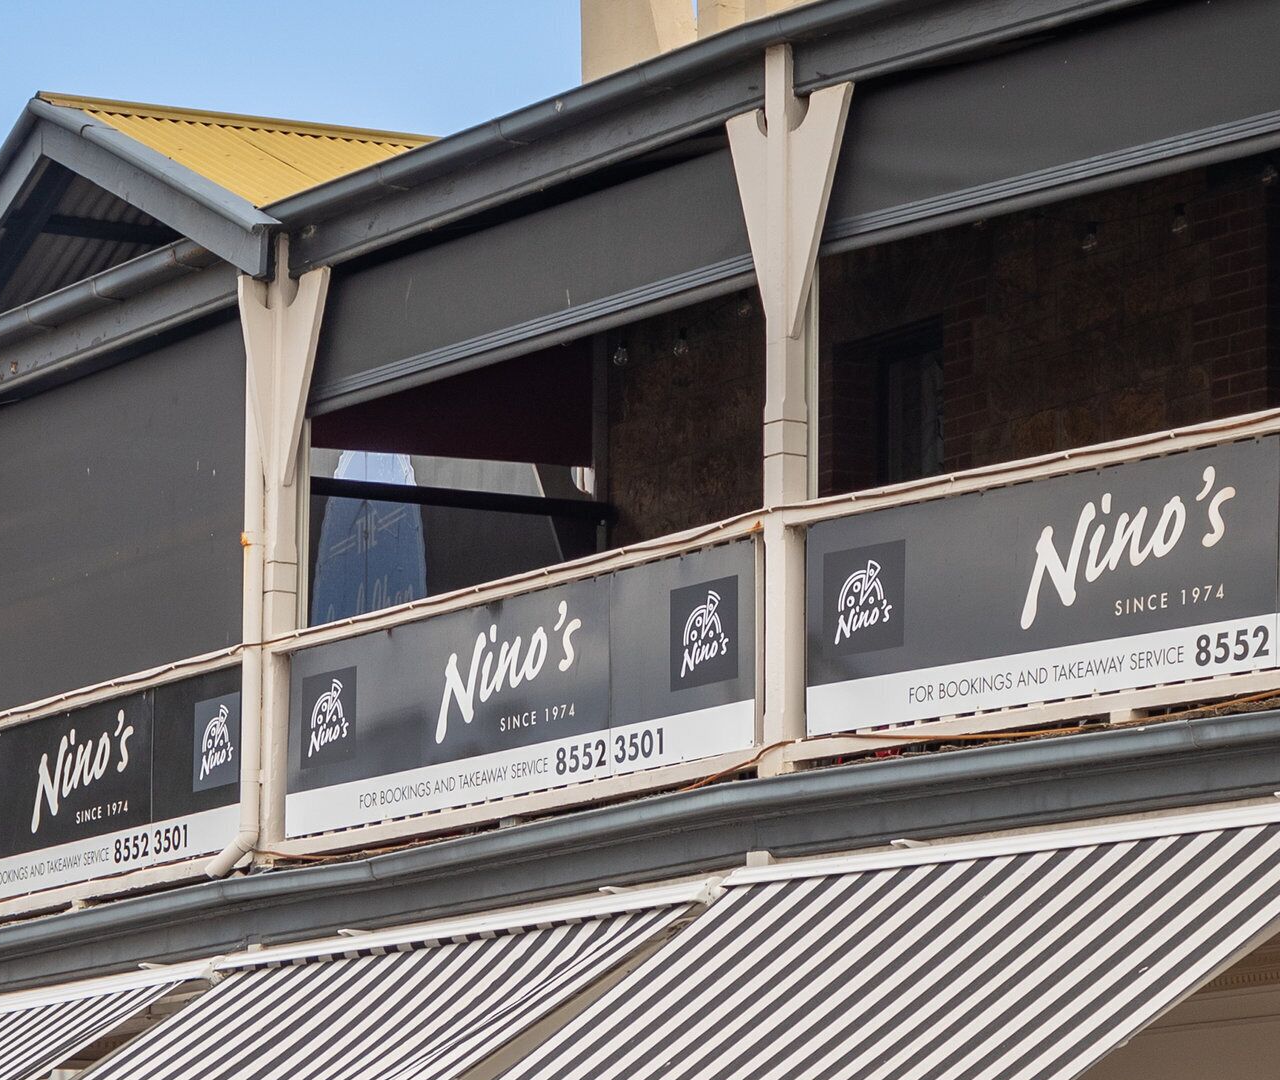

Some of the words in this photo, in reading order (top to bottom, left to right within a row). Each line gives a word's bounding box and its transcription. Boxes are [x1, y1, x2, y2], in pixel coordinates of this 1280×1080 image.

[1020, 465, 1236, 630] Nino's
[834, 600, 893, 646] Nino's
[1114, 591, 1169, 616] SINCE
[1179, 584, 1225, 606] 1974
[435, 600, 582, 744] Nino's
[680, 632, 729, 678] Nino's
[908, 684, 935, 704] FOR
[938, 671, 1013, 700] BOOKINGS
[1016, 665, 1049, 688] AND
[1052, 654, 1125, 683] TAKEAWAY
[1128, 644, 1185, 671] SERVICE
[1194, 623, 1271, 667] 8552
[307, 717, 350, 758] Nino's
[500, 711, 537, 732] SINCE
[544, 703, 576, 722] 1974
[30, 709, 135, 834] Nino's
[199, 742, 234, 781] Nino's
[359, 793, 377, 809] FOR
[379, 782, 432, 806] BOOKINGS
[434, 777, 456, 794] AND
[458, 767, 508, 790] TAKEAWAY
[510, 757, 548, 779] SERVICE
[555, 739, 607, 776] 8552
[614, 727, 665, 764] 3501
[75, 806, 102, 824] SINCE
[107, 800, 128, 817] 1974
[29, 863, 45, 877] AND
[46, 855, 81, 876] TAKEAWAY
[83, 847, 109, 867] SERVICE
[114, 833, 149, 864] 8552
[153, 824, 189, 855] 3501
